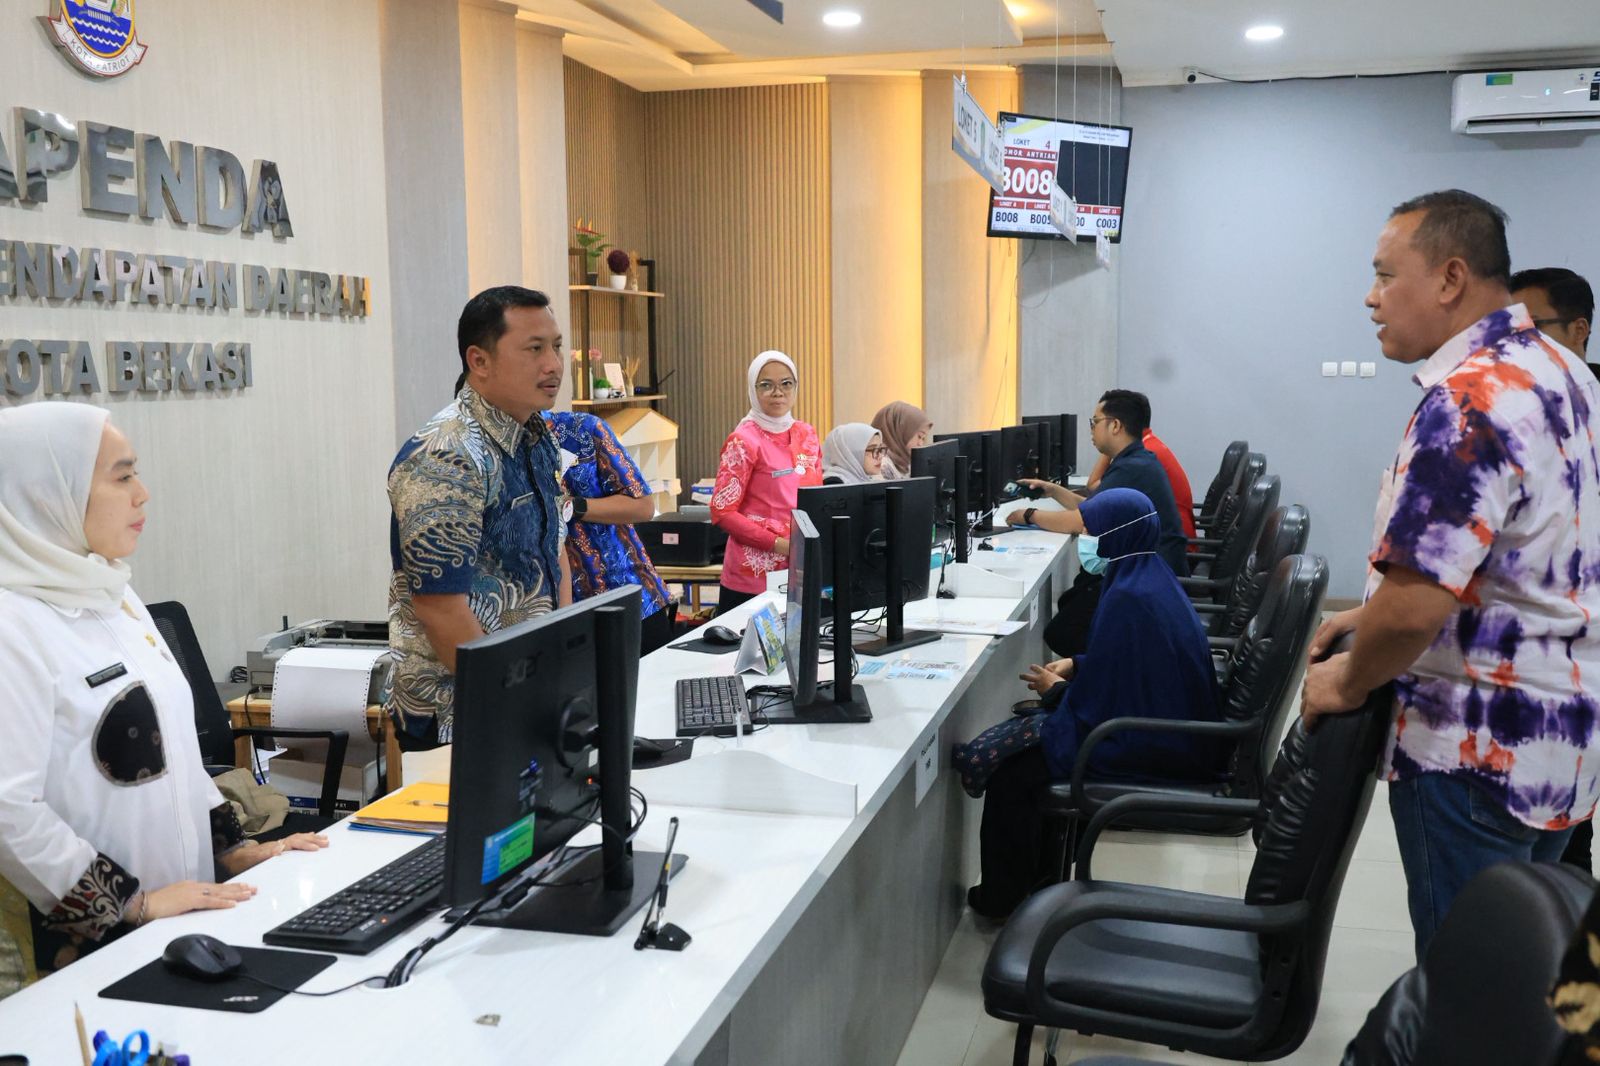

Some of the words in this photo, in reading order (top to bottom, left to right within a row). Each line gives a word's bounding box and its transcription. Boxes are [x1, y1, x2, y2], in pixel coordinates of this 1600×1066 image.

[96, 55, 130, 72] ATRIOT
[1013, 138, 1031, 146] LOKET
[1045, 140, 1051, 150] 4
[1026, 151, 1056, 160] ANTRIAN
[995, 211, 1018, 223] B008
[1096, 217, 1117, 228] C003
[243, 264, 371, 317] DAERAH
[0, 338, 101, 395] OTA
[106, 340, 253, 392] BEKASI
